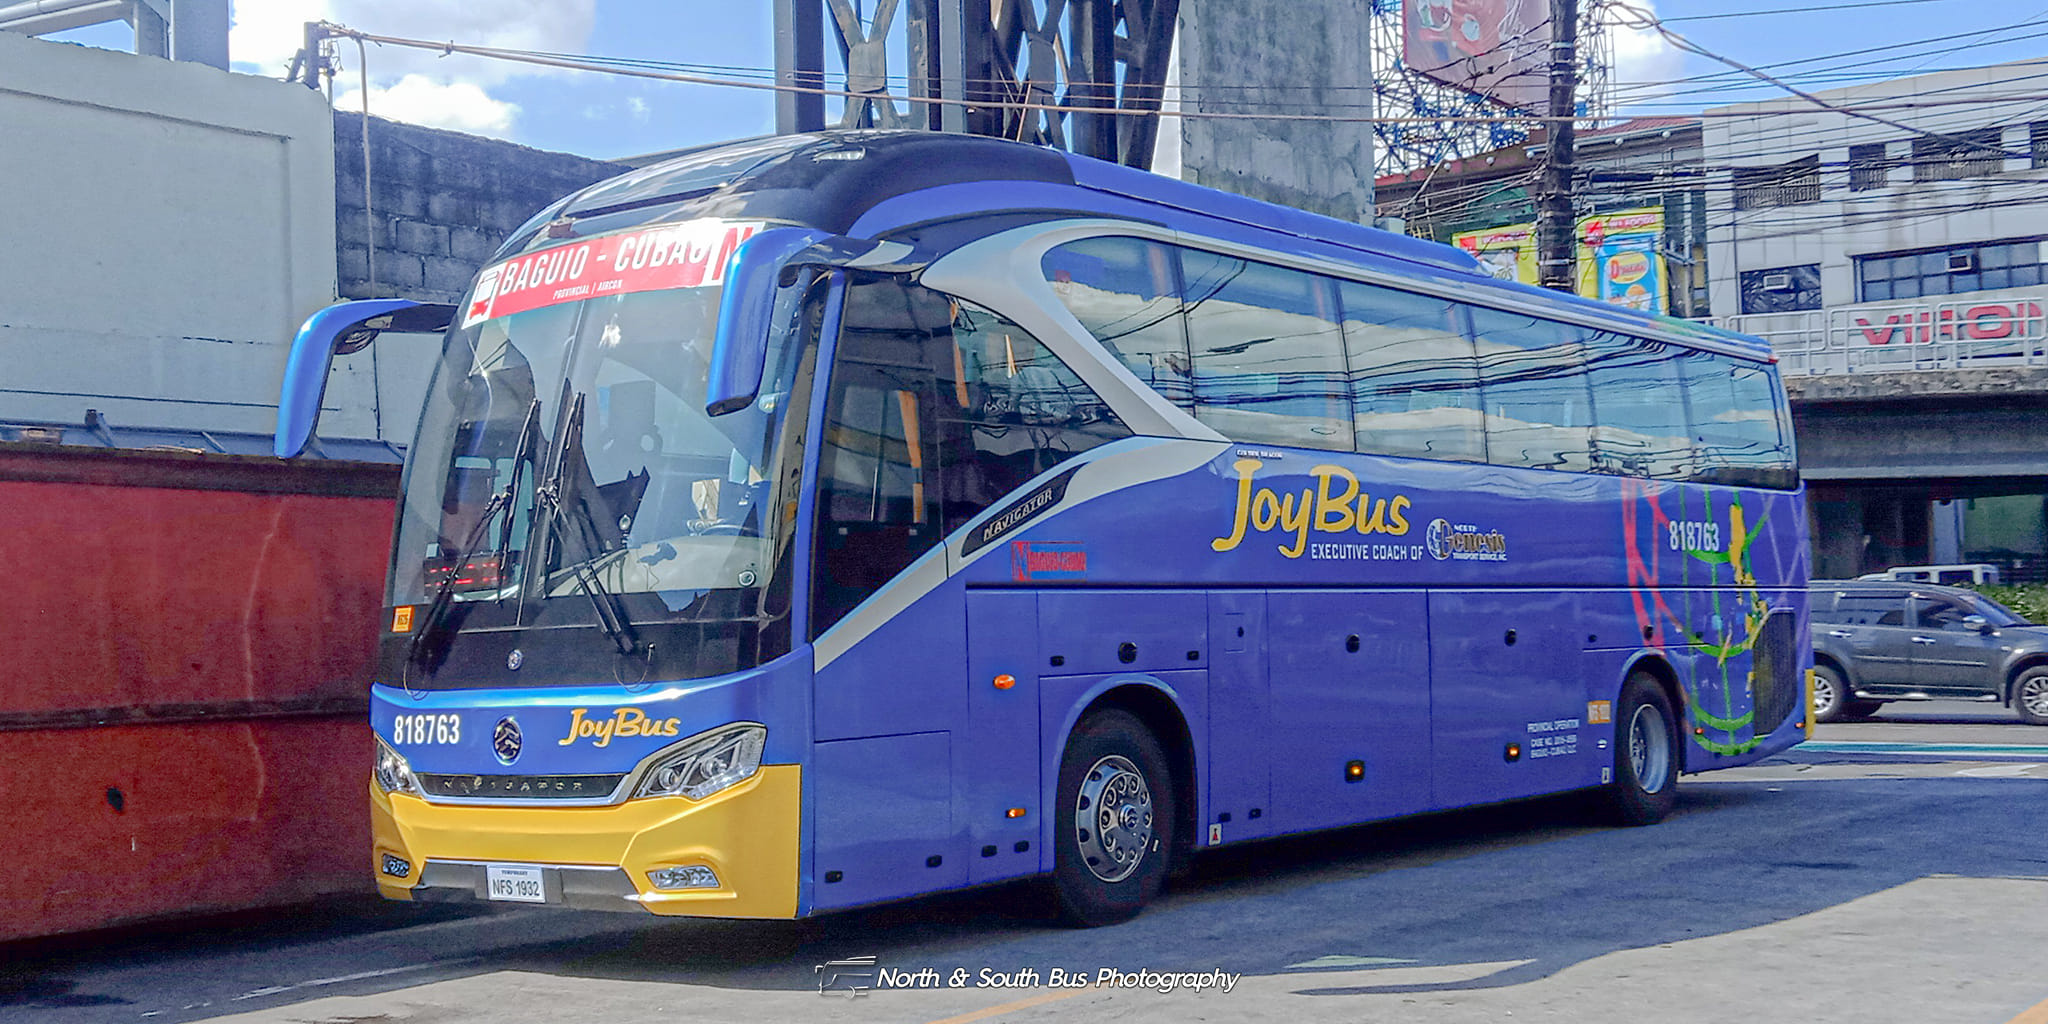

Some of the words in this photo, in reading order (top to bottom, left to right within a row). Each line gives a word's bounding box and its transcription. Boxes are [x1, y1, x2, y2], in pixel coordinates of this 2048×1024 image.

[499, 245, 590, 296] BAGUIO
[613, 229, 709, 273] CUBAO
[552, 284, 590, 301] PROVINCIAL
[597, 278, 624, 293] AIRCON
[983, 487, 1053, 542] NAVIGATOR
[1211, 459, 1411, 558] JoyBus
[1311, 543, 1369, 560] EXECUTIVE
[1373, 544, 1407, 560] COACH
[1411, 545, 1424, 561] OF
[1669, 520, 1720, 552] 818763
[394, 713, 461, 745] 818763
[558, 707, 681, 748] JoyBus
[492, 879, 513, 896] NFS
[516, 880, 540, 897] 1932
